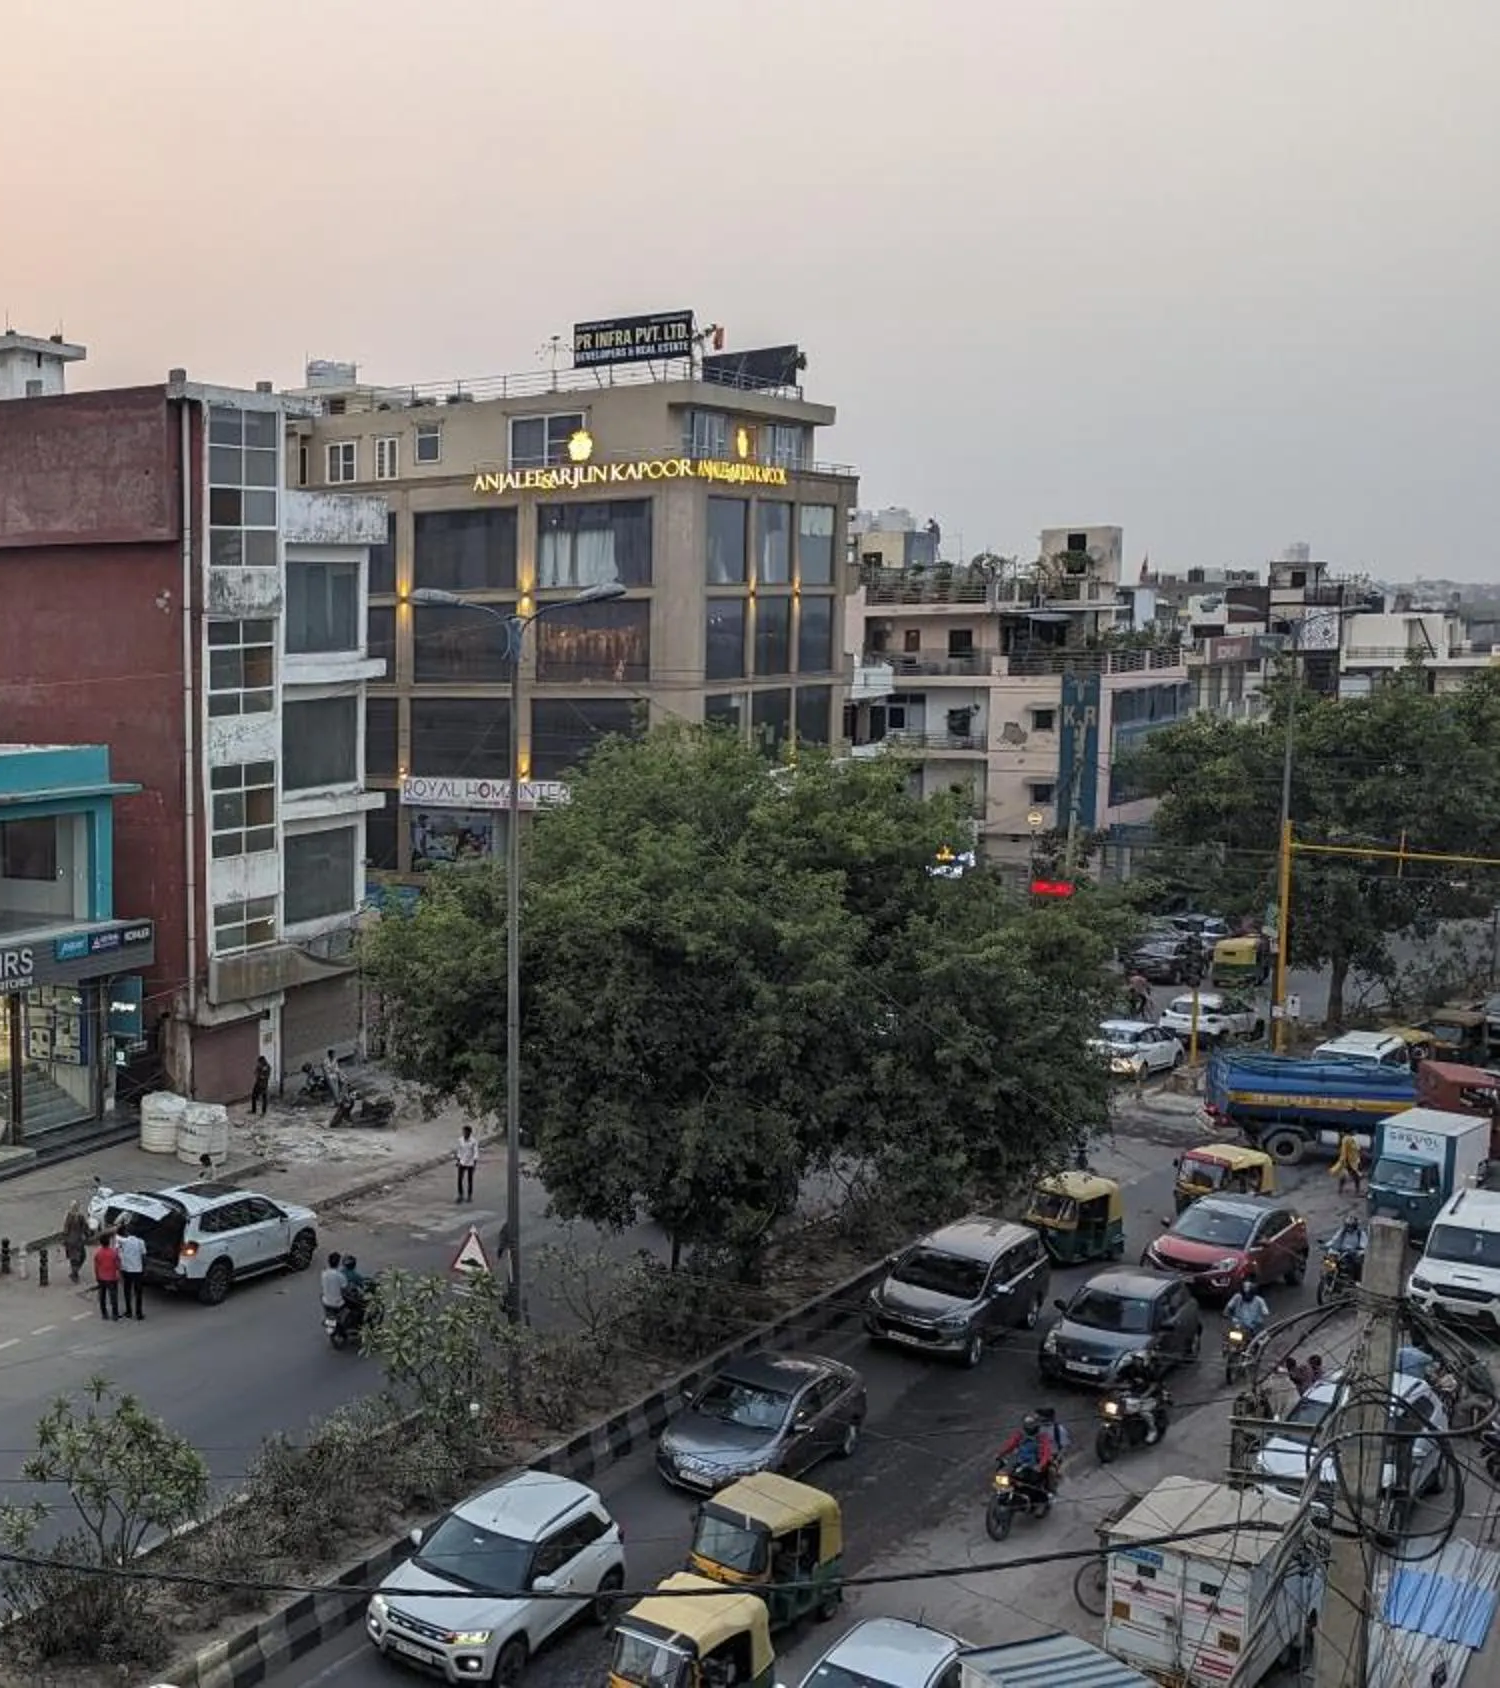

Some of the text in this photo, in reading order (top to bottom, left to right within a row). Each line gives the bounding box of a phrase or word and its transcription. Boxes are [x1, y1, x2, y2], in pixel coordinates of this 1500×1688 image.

[576, 333, 592, 350] PR
[595, 329, 632, 349] INFRA
[635, 325, 661, 344] PVT.
[576, 348, 627, 362] DEVELOPERS
[658, 341, 689, 353] ESTATE
[611, 457, 695, 482] KAPOOR
[404, 780, 460, 798] ROYAL
[520, 783, 571, 802] INTER
